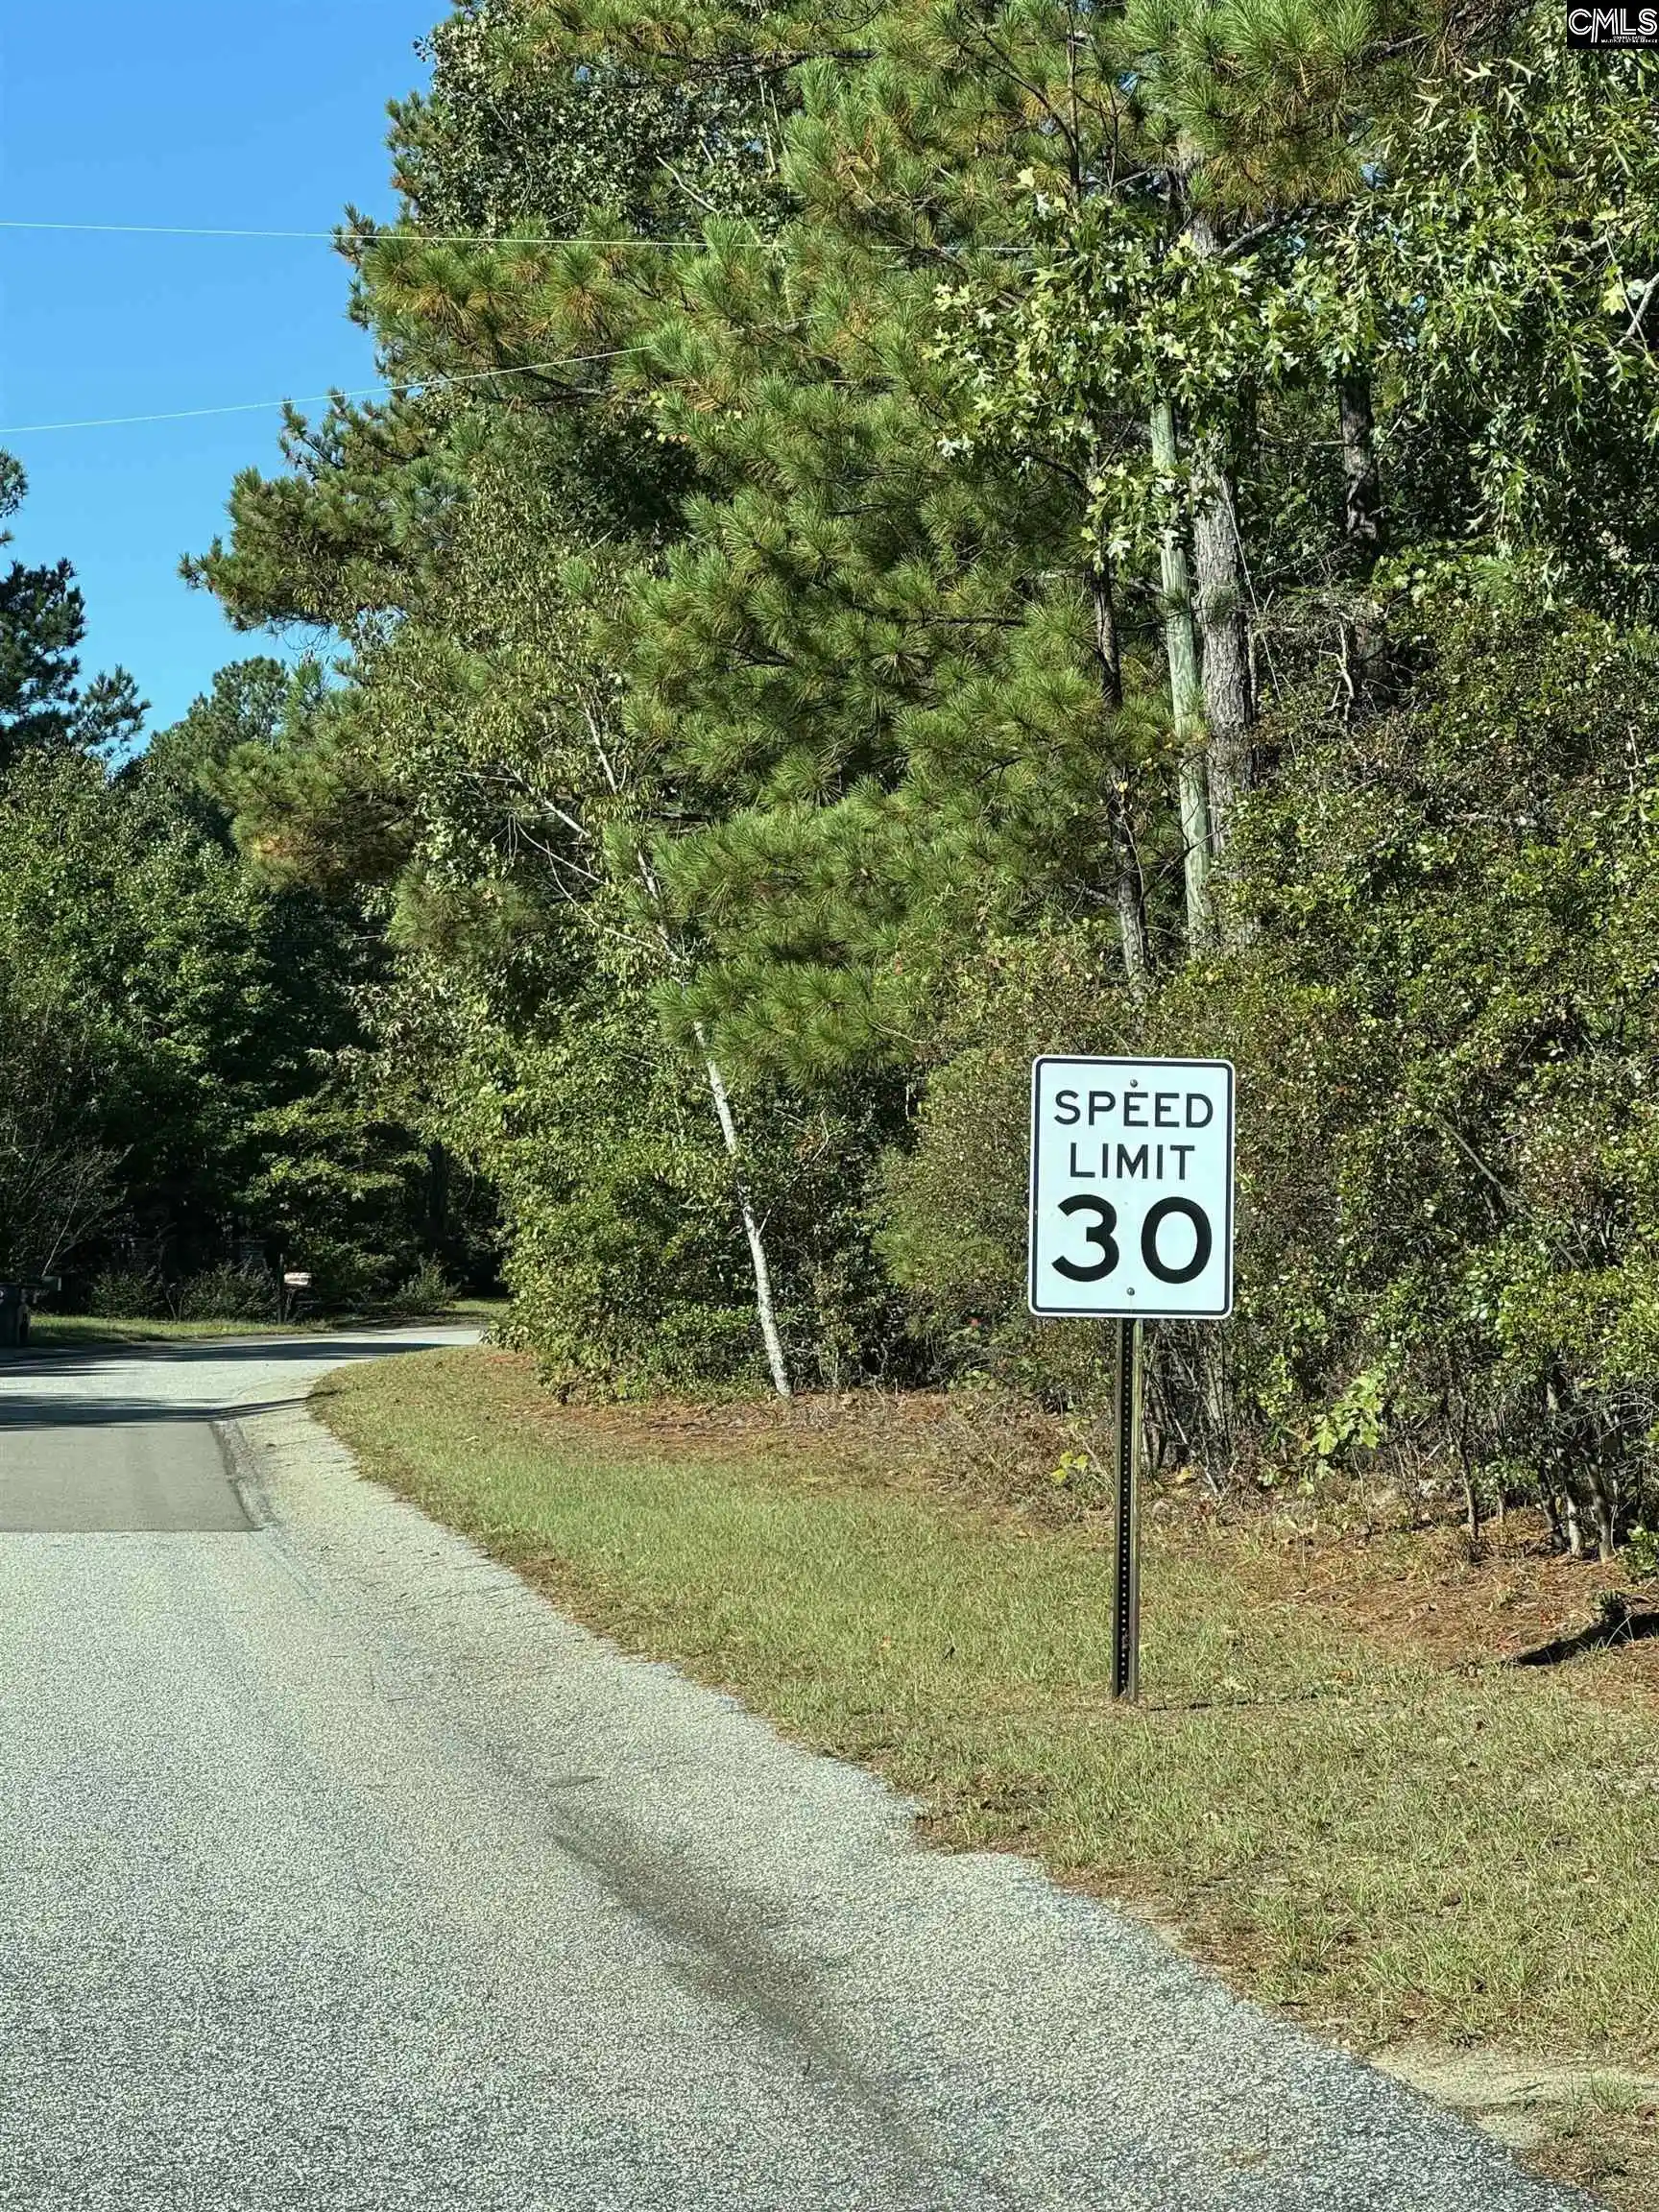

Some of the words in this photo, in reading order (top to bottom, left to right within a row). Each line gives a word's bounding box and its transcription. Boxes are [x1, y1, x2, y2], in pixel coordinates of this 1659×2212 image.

[1053, 1089, 1214, 1128] SPEED
[1070, 1142, 1195, 1181] LIMIT
[1051, 1193, 1213, 1285] 30
